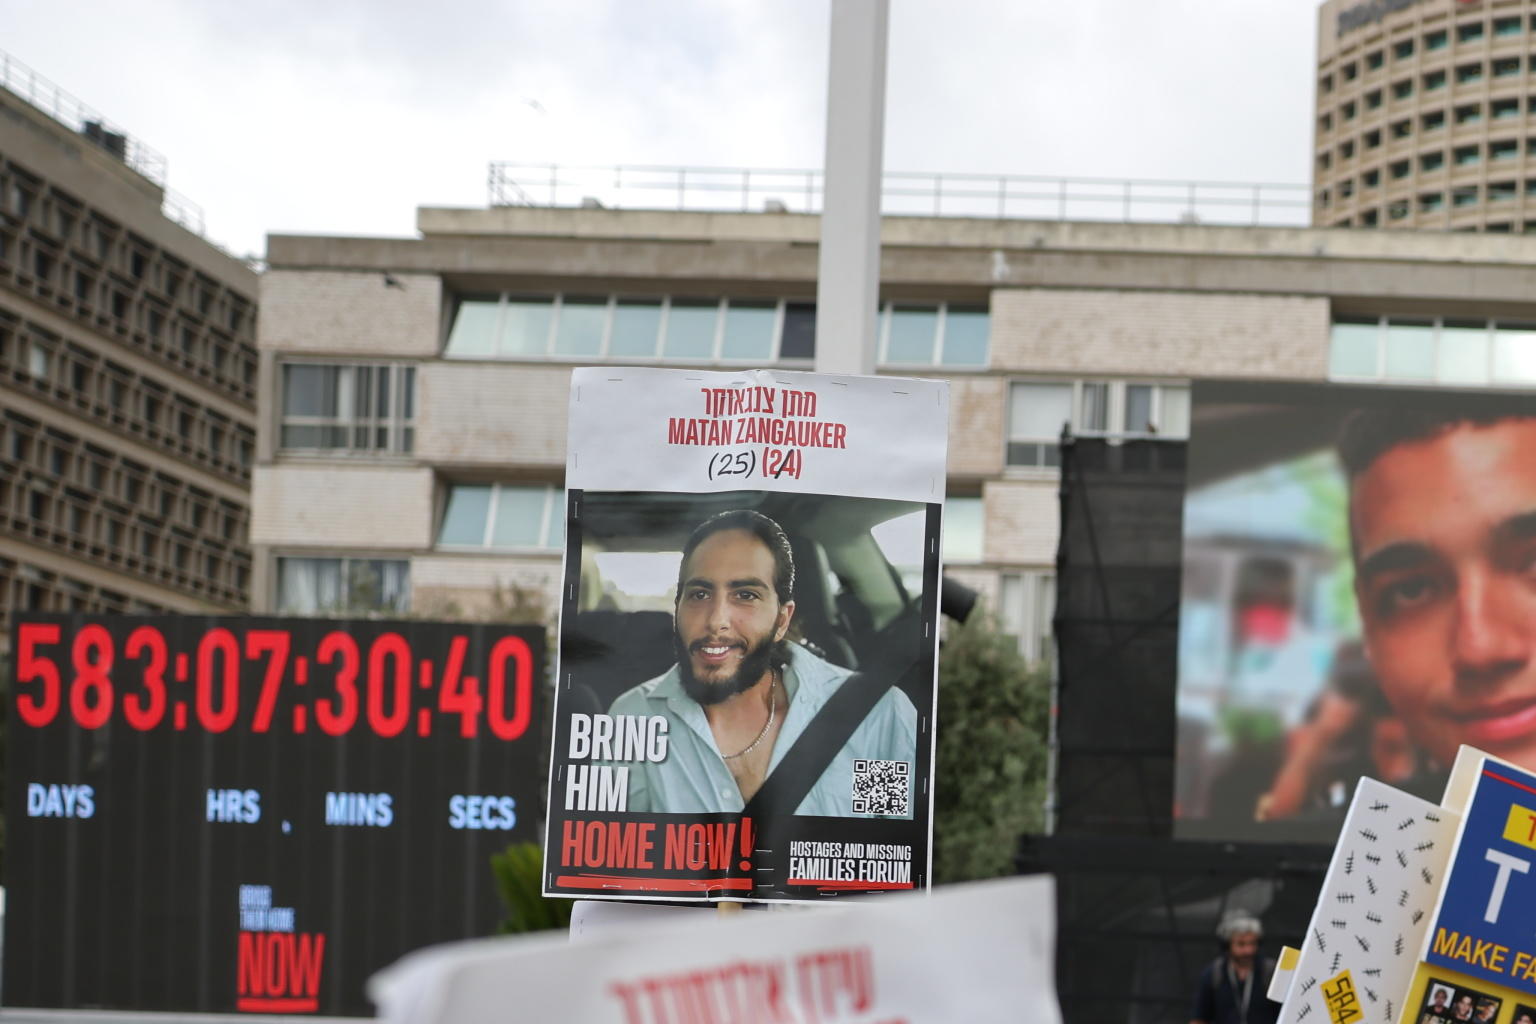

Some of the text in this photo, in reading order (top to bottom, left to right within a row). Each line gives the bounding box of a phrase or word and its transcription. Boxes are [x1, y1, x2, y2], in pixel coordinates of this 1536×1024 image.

[701, 386, 817, 418] מתן צנגאוקר
[668, 417, 847, 449] MATAN ZANGAUKER
[708, 450, 756, 480] (25)
[568, 713, 669, 763] BRING
[27, 783, 95, 819] DAYS
[565, 764, 629, 812] HIM
[206, 789, 260, 824] HRS
[325, 792, 393, 827] MINS
[449, 795, 516, 830] SECS
[561, 817, 755, 872] HOME NOW!
[790, 841, 911, 860] HOSTAGES AND MISSING
[789, 857, 911, 884] FAMILIES FORUM
[237, 931, 326, 996] NOW
[1433, 928, 1509, 973] MAKE
